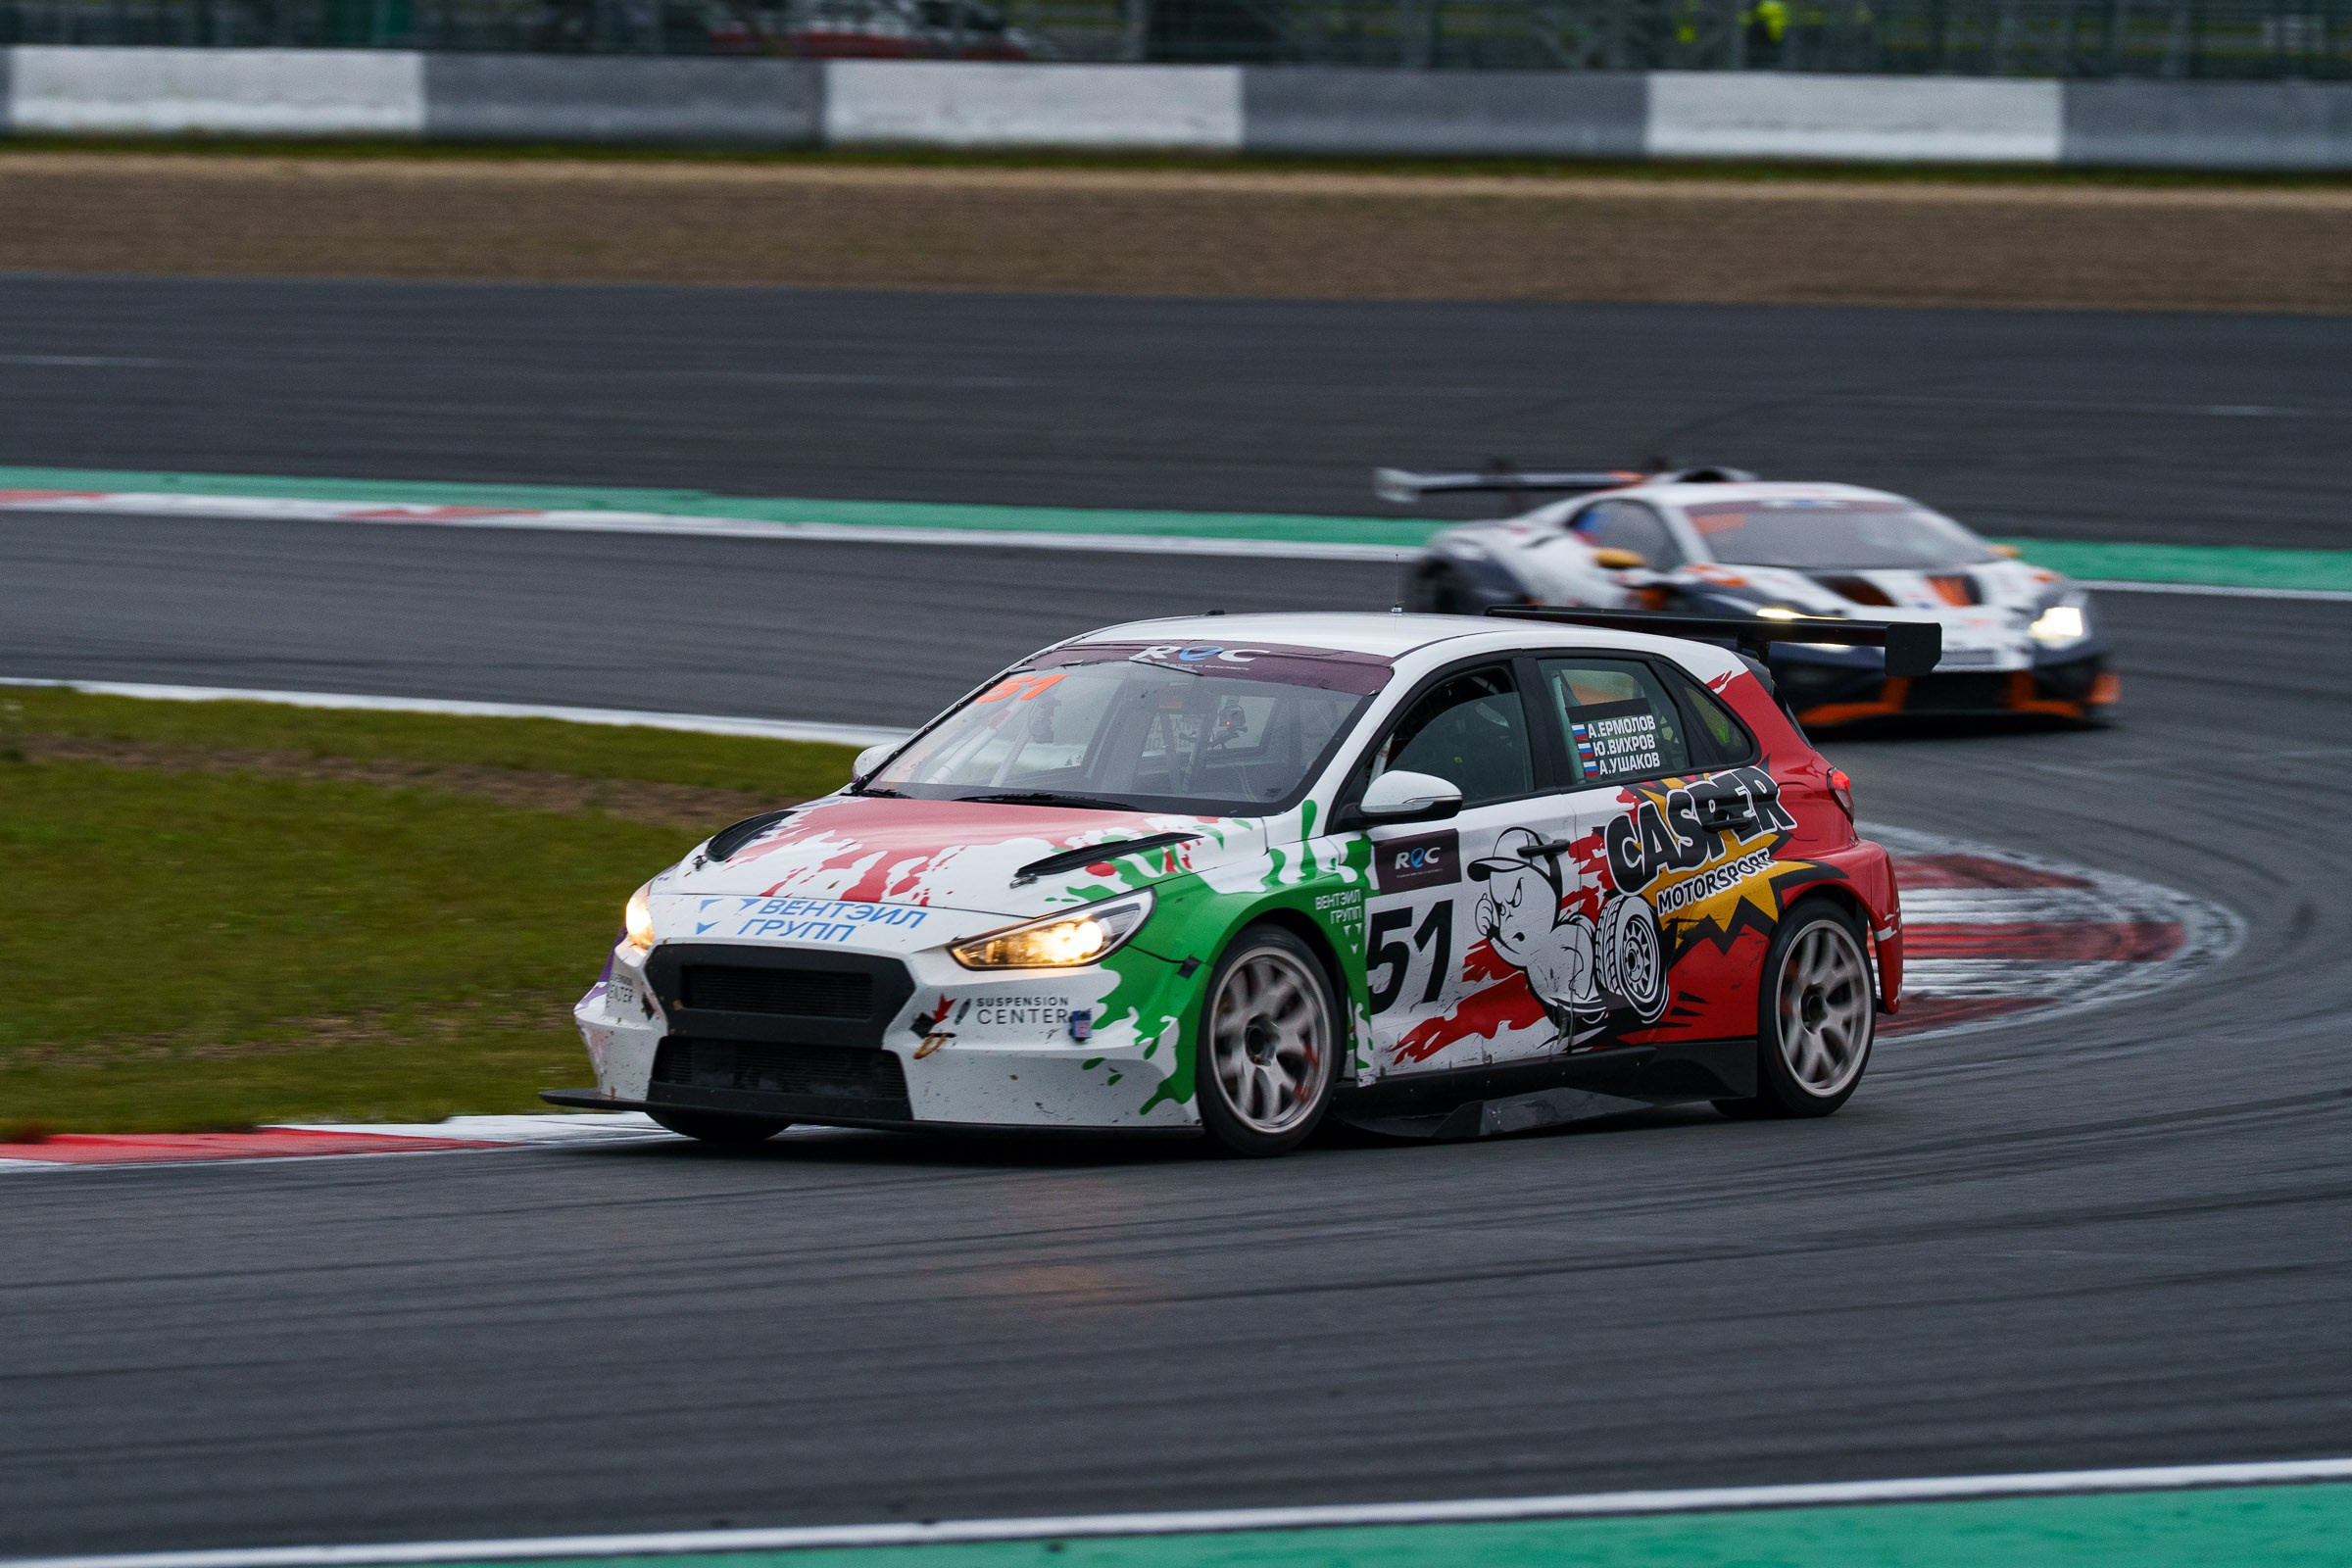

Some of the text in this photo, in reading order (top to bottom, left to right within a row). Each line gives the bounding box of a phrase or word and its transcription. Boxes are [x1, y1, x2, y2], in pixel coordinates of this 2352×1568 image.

[974, 673, 1067, 704] 51
[1588, 714, 1655, 739] А.ЕРМОЛОВ
[1592, 733, 1655, 758] Ю.ВИХРОВ
[1599, 752, 1660, 775] А.УШАКОВ
[1604, 766, 1797, 896] CASPER
[1656, 849, 1778, 916] MOTORSPORT
[1315, 889, 1361, 910] ВЕНТЭИЛ
[758, 899, 928, 929] ВЕНТЭИЛ
[1330, 906, 1362, 925] ГРУПП
[737, 918, 857, 942] ГРУПП
[1366, 899, 1453, 1016] 51
[976, 997, 1069, 1007] SUSPENSION
[976, 1008, 1069, 1025] CENTER
